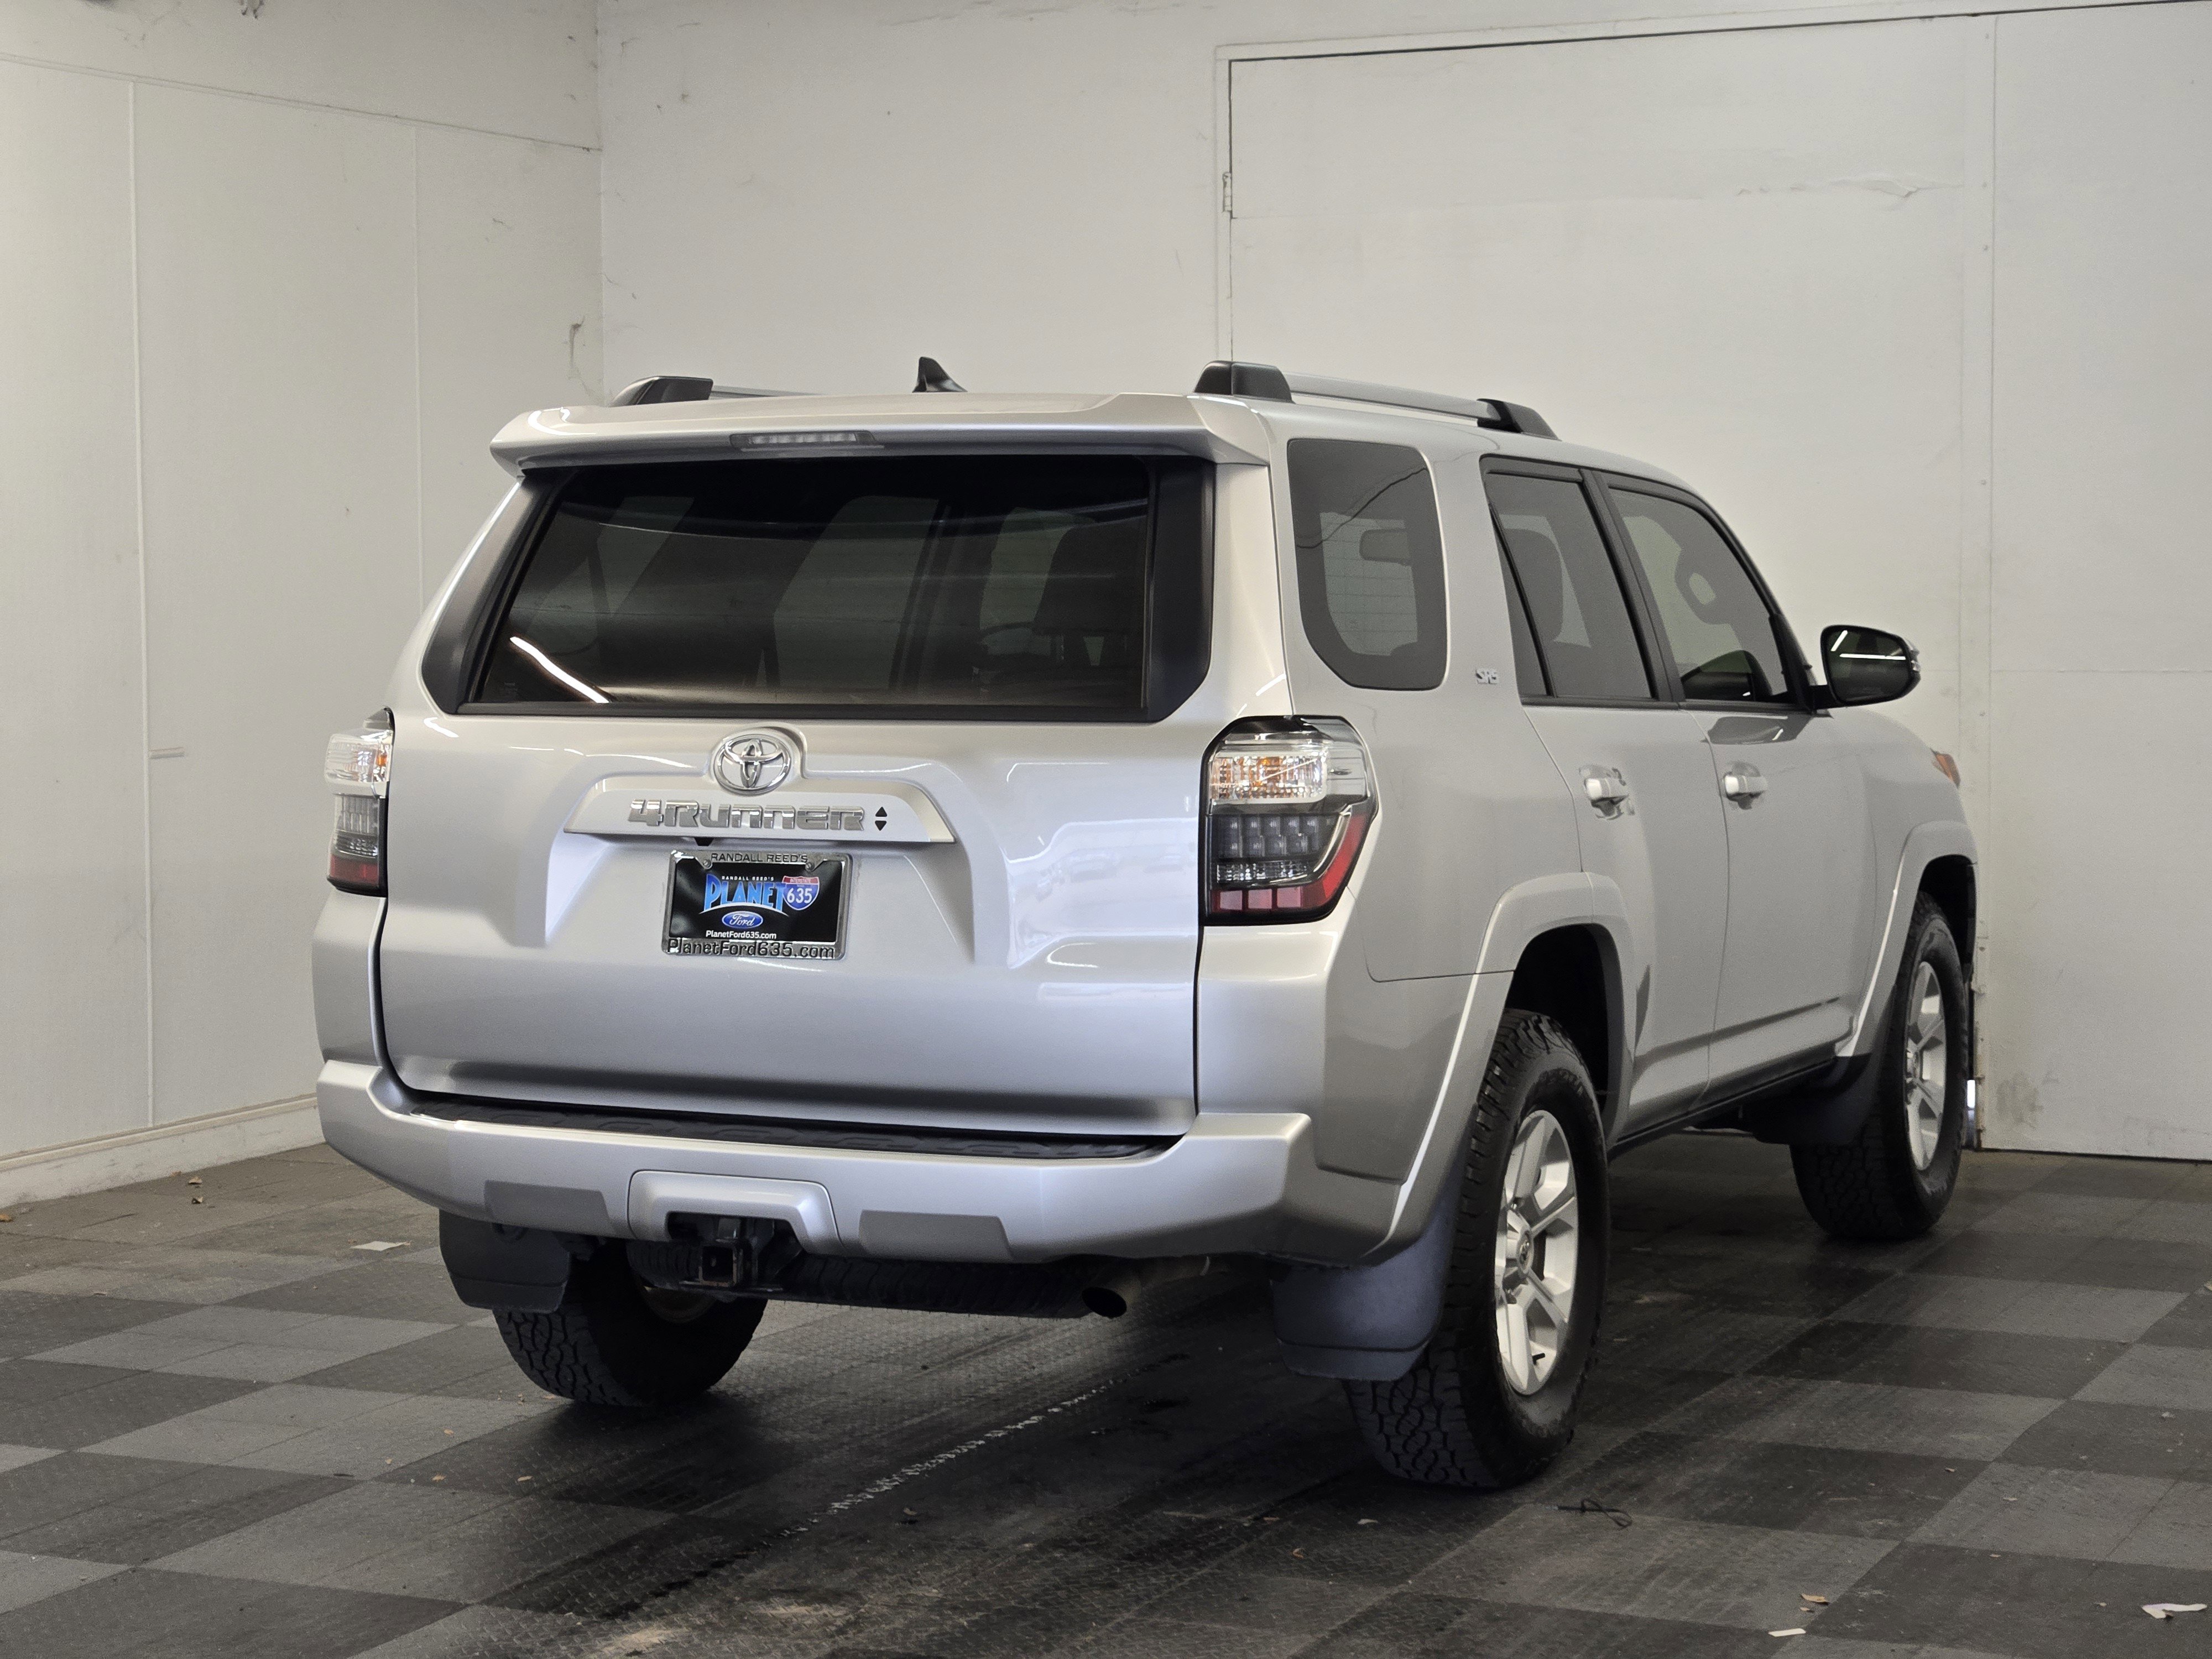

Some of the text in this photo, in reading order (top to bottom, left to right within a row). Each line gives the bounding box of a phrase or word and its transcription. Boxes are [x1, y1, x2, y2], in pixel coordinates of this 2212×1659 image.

[711, 853, 808, 863] RANDALL REED'S
[703, 873, 787, 912] PLANET
[787, 888, 812, 904] 635
[729, 913, 756, 926] Ford
[706, 930, 777, 940] PlanetFord635.com
[667, 938, 835, 959] PlanetFord635.com
